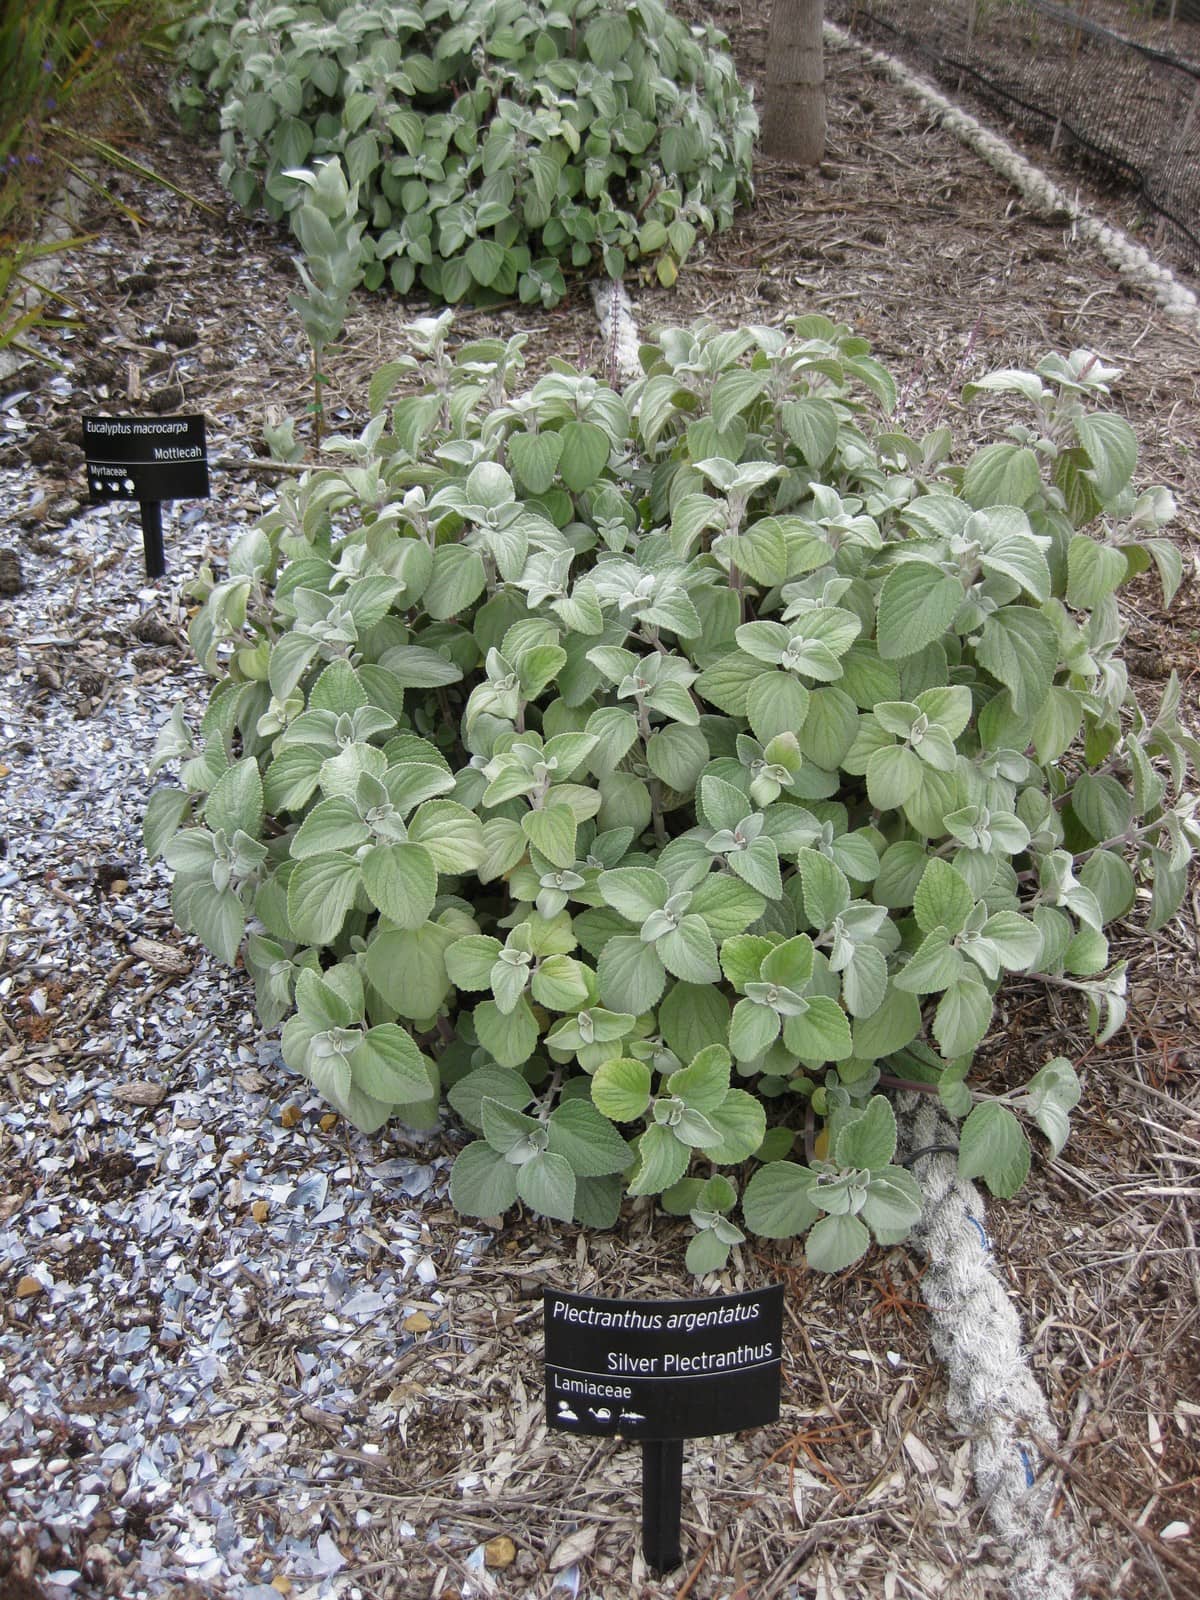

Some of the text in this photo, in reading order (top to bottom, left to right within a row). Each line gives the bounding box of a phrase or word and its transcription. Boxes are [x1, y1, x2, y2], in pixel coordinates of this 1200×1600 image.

[87, 421, 188, 436] Eucalyptus macrocarpa
[154, 446, 202, 460] Mottlecah
[90, 465, 128, 477] Myrtaceae
[553, 1301, 760, 1332] Plectranthus argentatus
[607, 1342, 773, 1372] Silver Plectranthus
[554, 1373, 632, 1399] Lamiaceae
